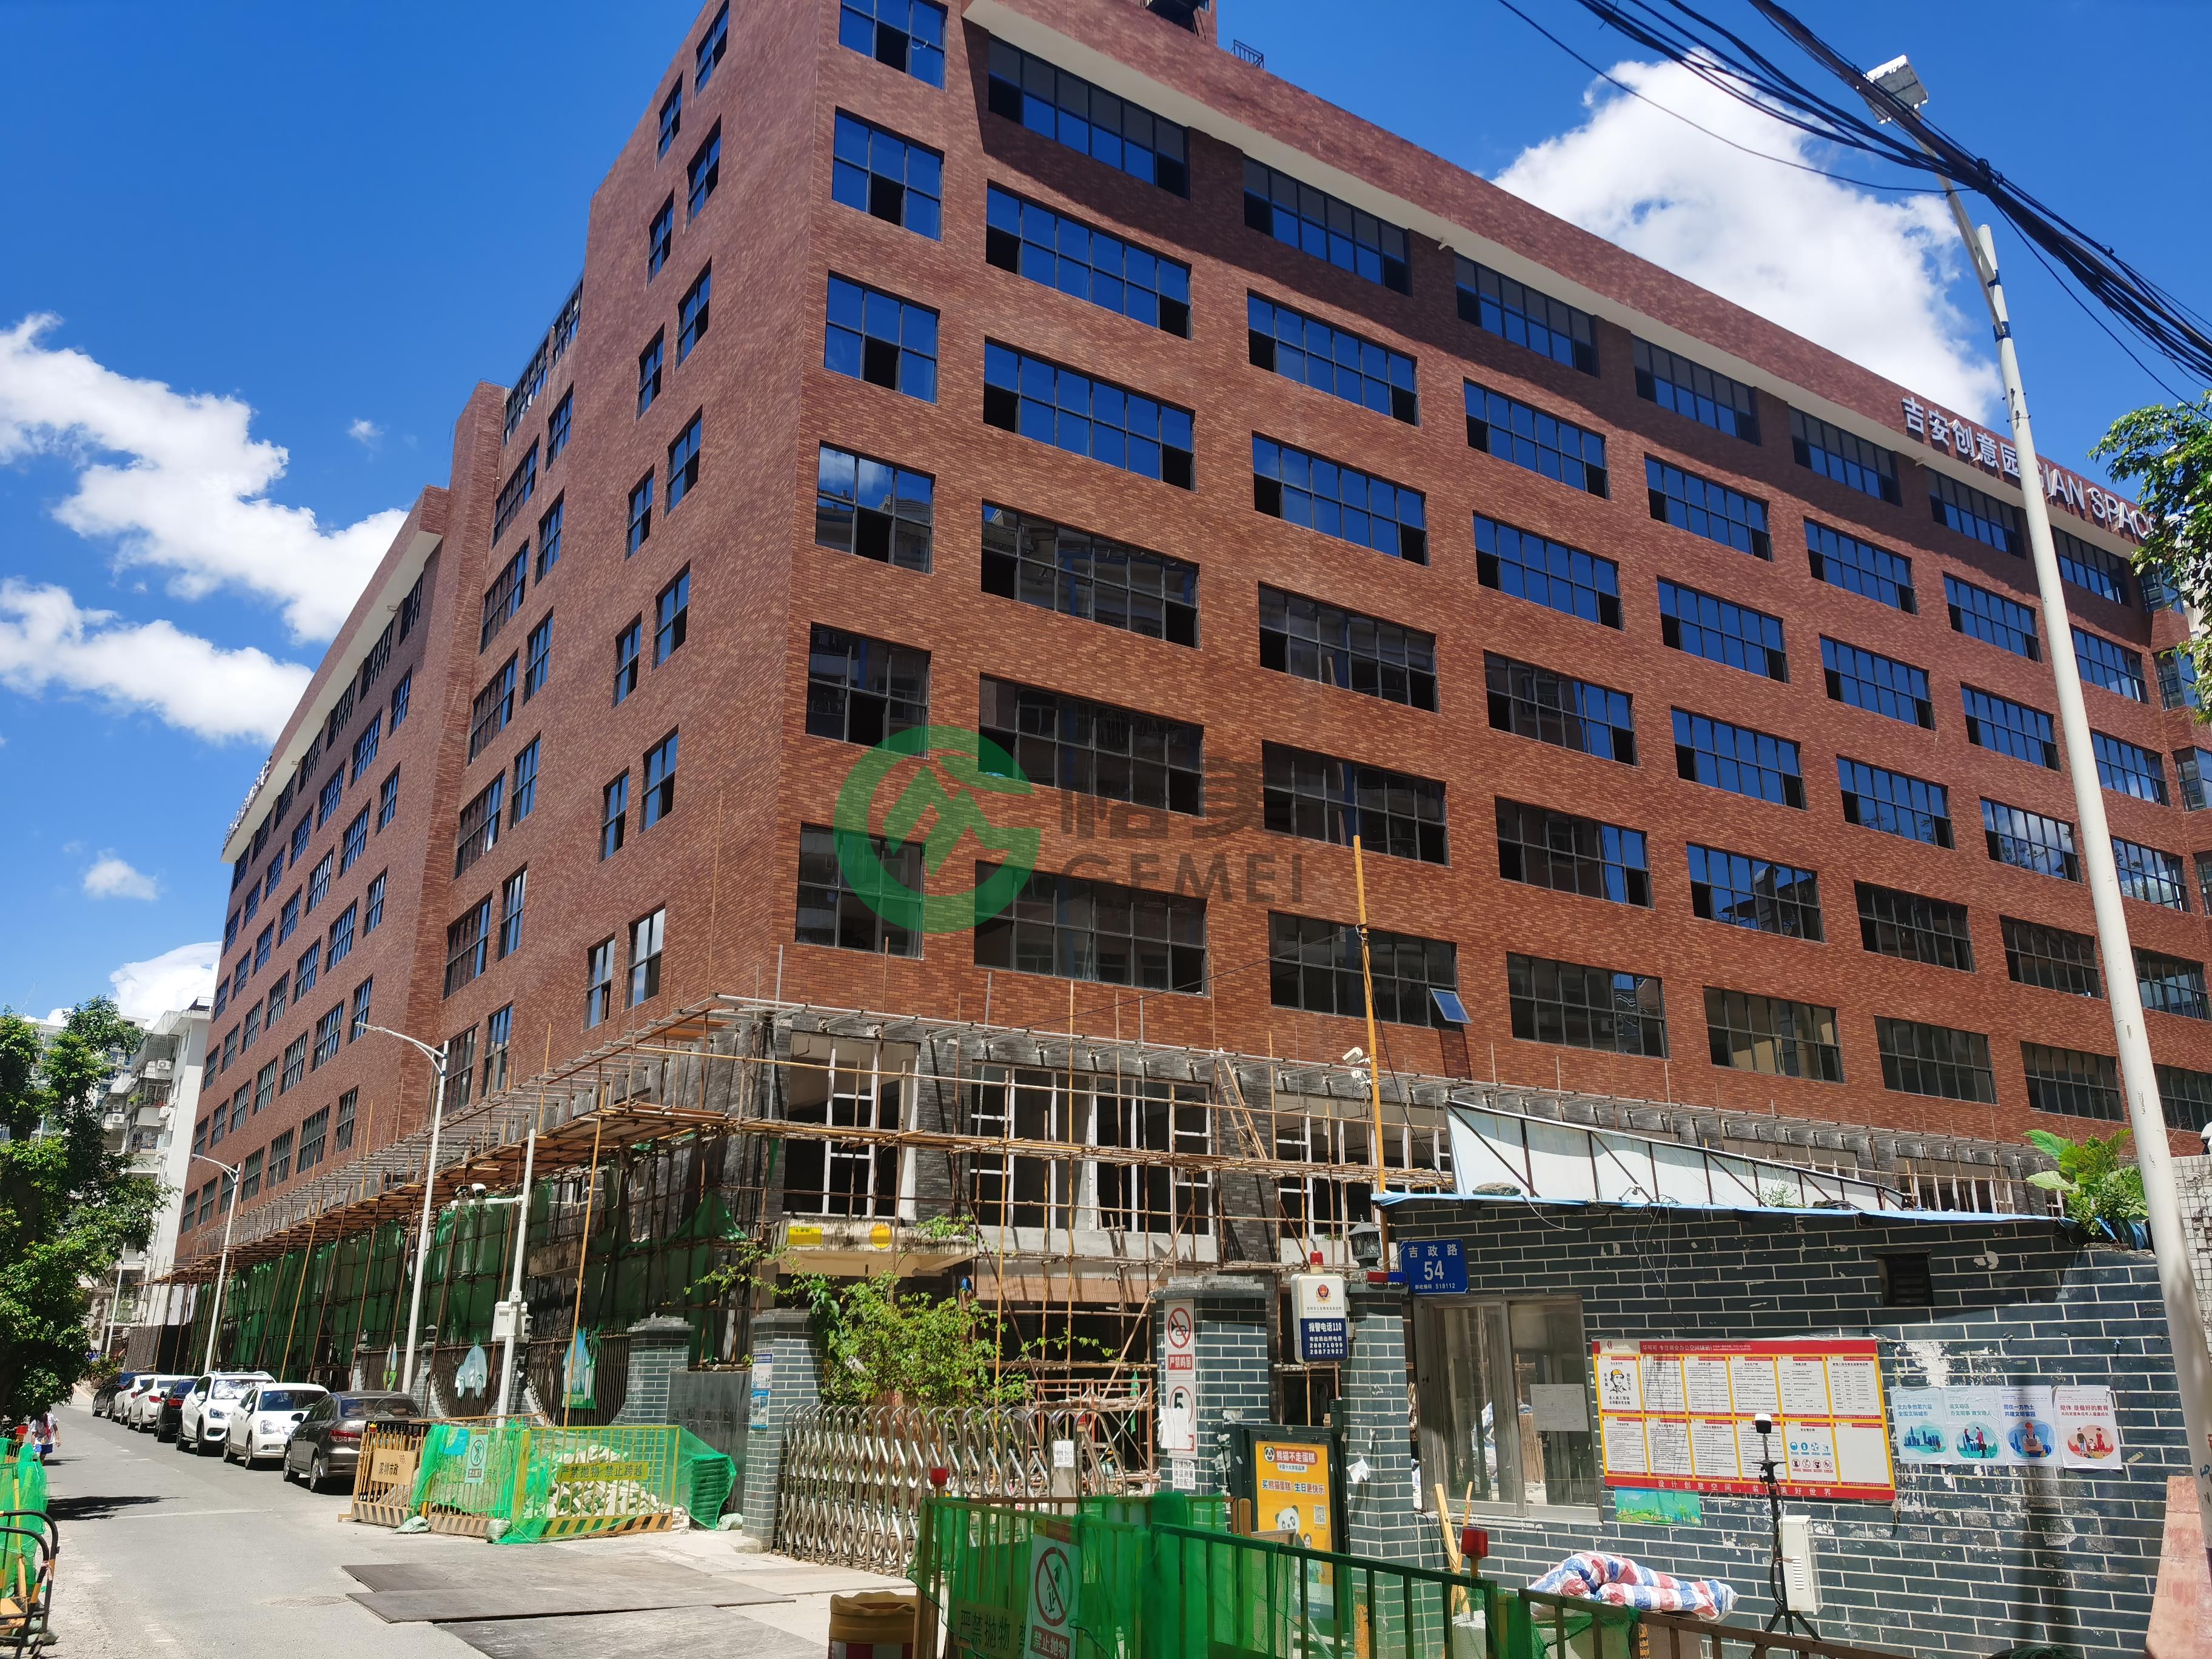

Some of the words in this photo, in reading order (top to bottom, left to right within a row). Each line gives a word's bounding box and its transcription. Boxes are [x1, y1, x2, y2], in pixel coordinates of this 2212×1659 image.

[1902, 397, 2020, 478] 吉安创意园
[1408, 1244, 1458, 1258] 吉政路
[1424, 1261, 1444, 1281] 54
[1309, 1322, 1342, 1332] 报警电话110
[1169, 1356, 1191, 1369] 严禁鸣笛
[1276, 1450, 1315, 1463] 熊猫不走蛋糕
[378, 1461, 398, 1476] 深圳市政
[560, 1466, 599, 1478] 严禁抛物
[605, 1464, 643, 1478] 禁止跨越
[1174, 1469, 1193, 1478] 体温测量
[1174, 1478, 1194, 1486] 请您配合
[1033, 1631, 1067, 1659] 禁止抛物
